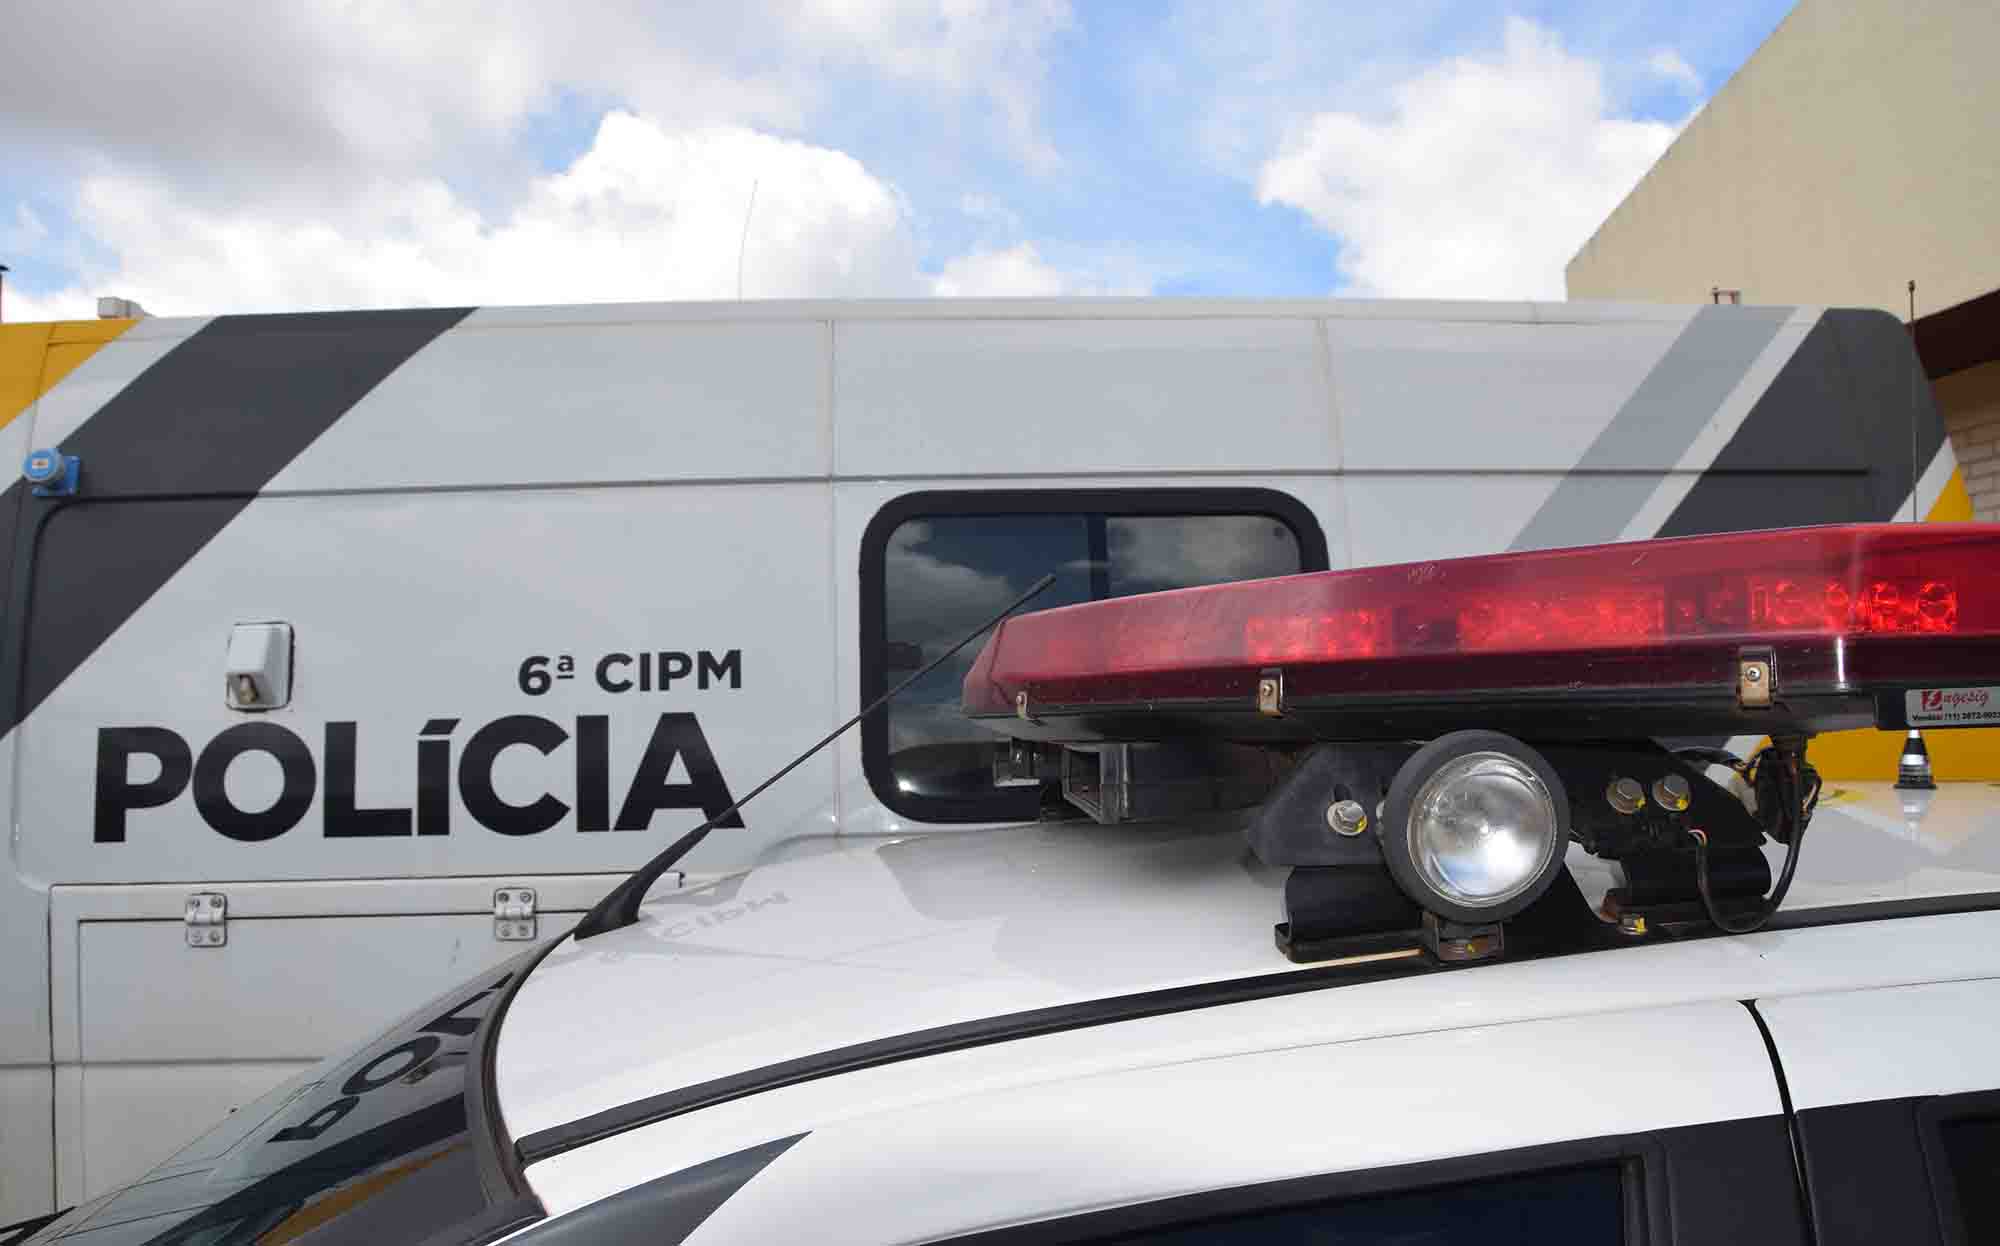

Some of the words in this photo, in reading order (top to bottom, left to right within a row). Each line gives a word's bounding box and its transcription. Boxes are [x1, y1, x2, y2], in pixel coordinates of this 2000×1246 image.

[518, 655, 575, 696] 6ª
[594, 649, 743, 693] CIPM
[93, 712, 746, 843] POLÍCIA
